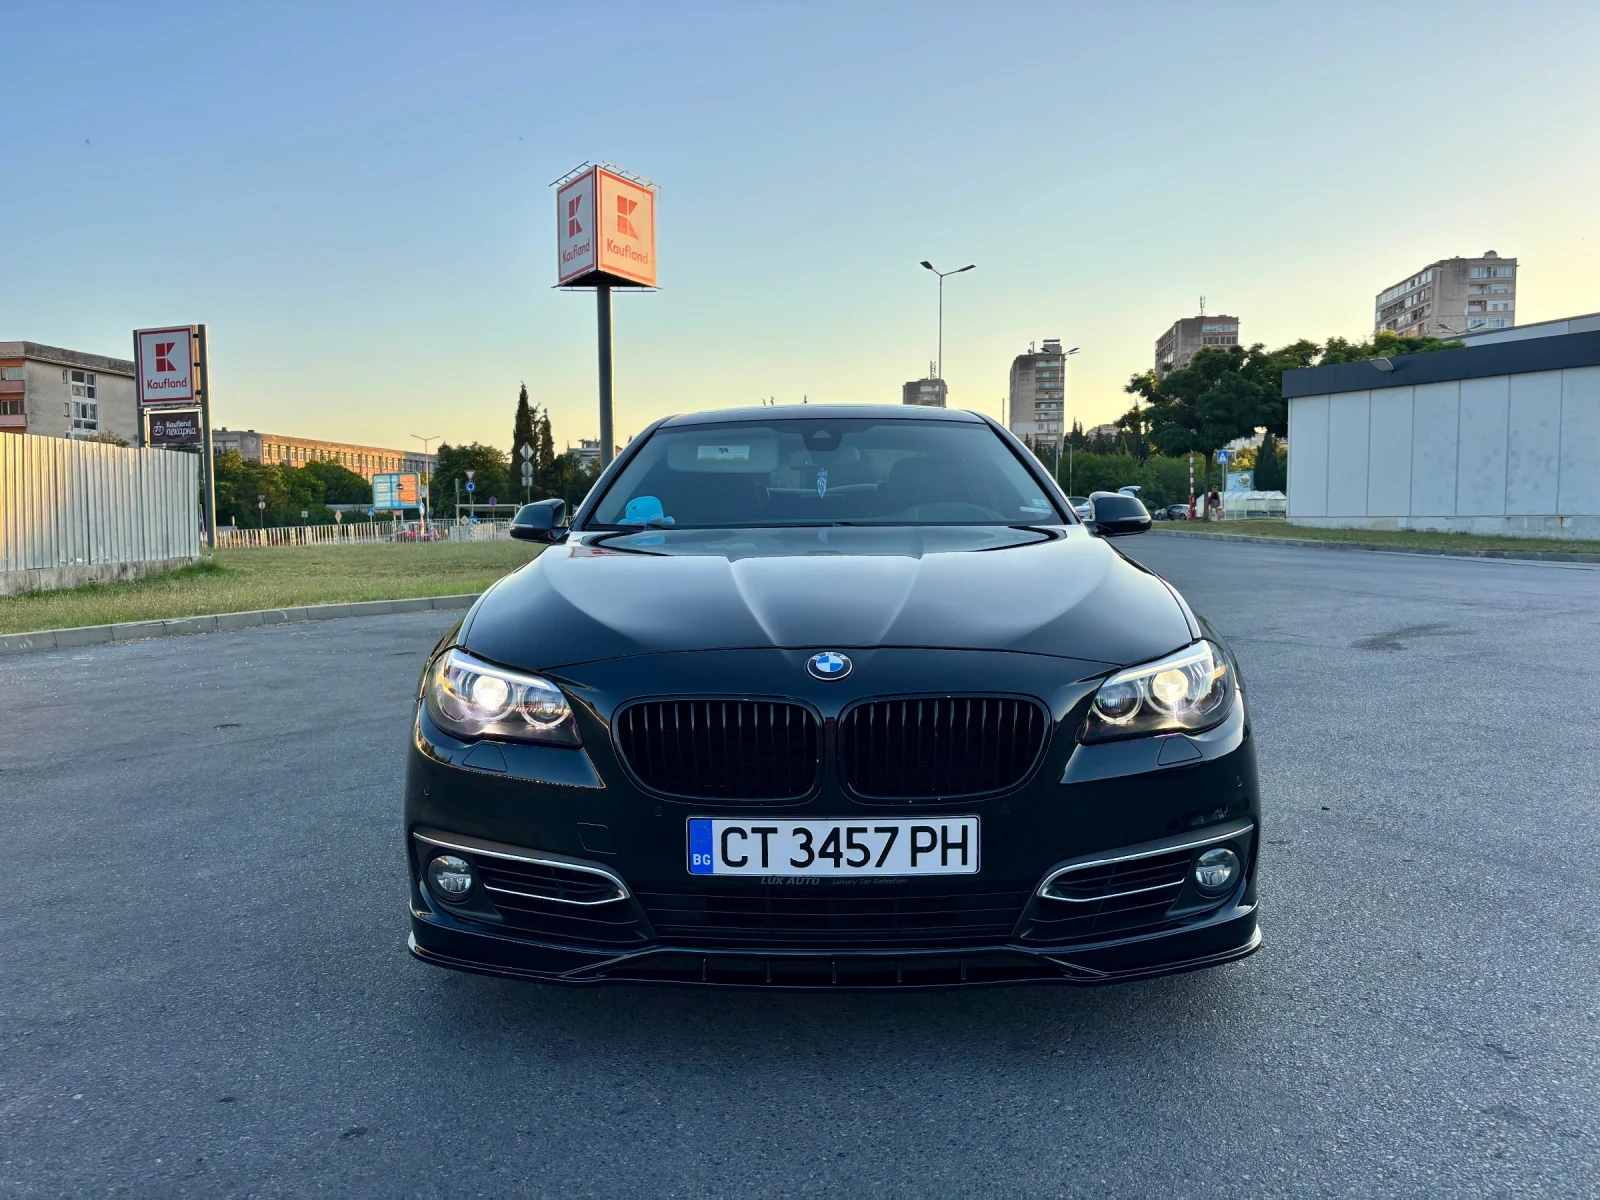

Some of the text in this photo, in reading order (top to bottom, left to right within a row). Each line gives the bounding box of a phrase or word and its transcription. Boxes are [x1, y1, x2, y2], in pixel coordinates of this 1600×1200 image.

[562, 238, 591, 264] Kaufland
[607, 238, 649, 265] Kaufland
[147, 377, 187, 390] Kaufland
[166, 420, 192, 428] Kaufland
[721, 825, 968, 868] CT 3457 PH
[693, 853, 711, 866] BG
[760, 876, 820, 885] LUX AUTO
[832, 878, 858, 886] Luxury
[873, 877, 908, 885] Selection
